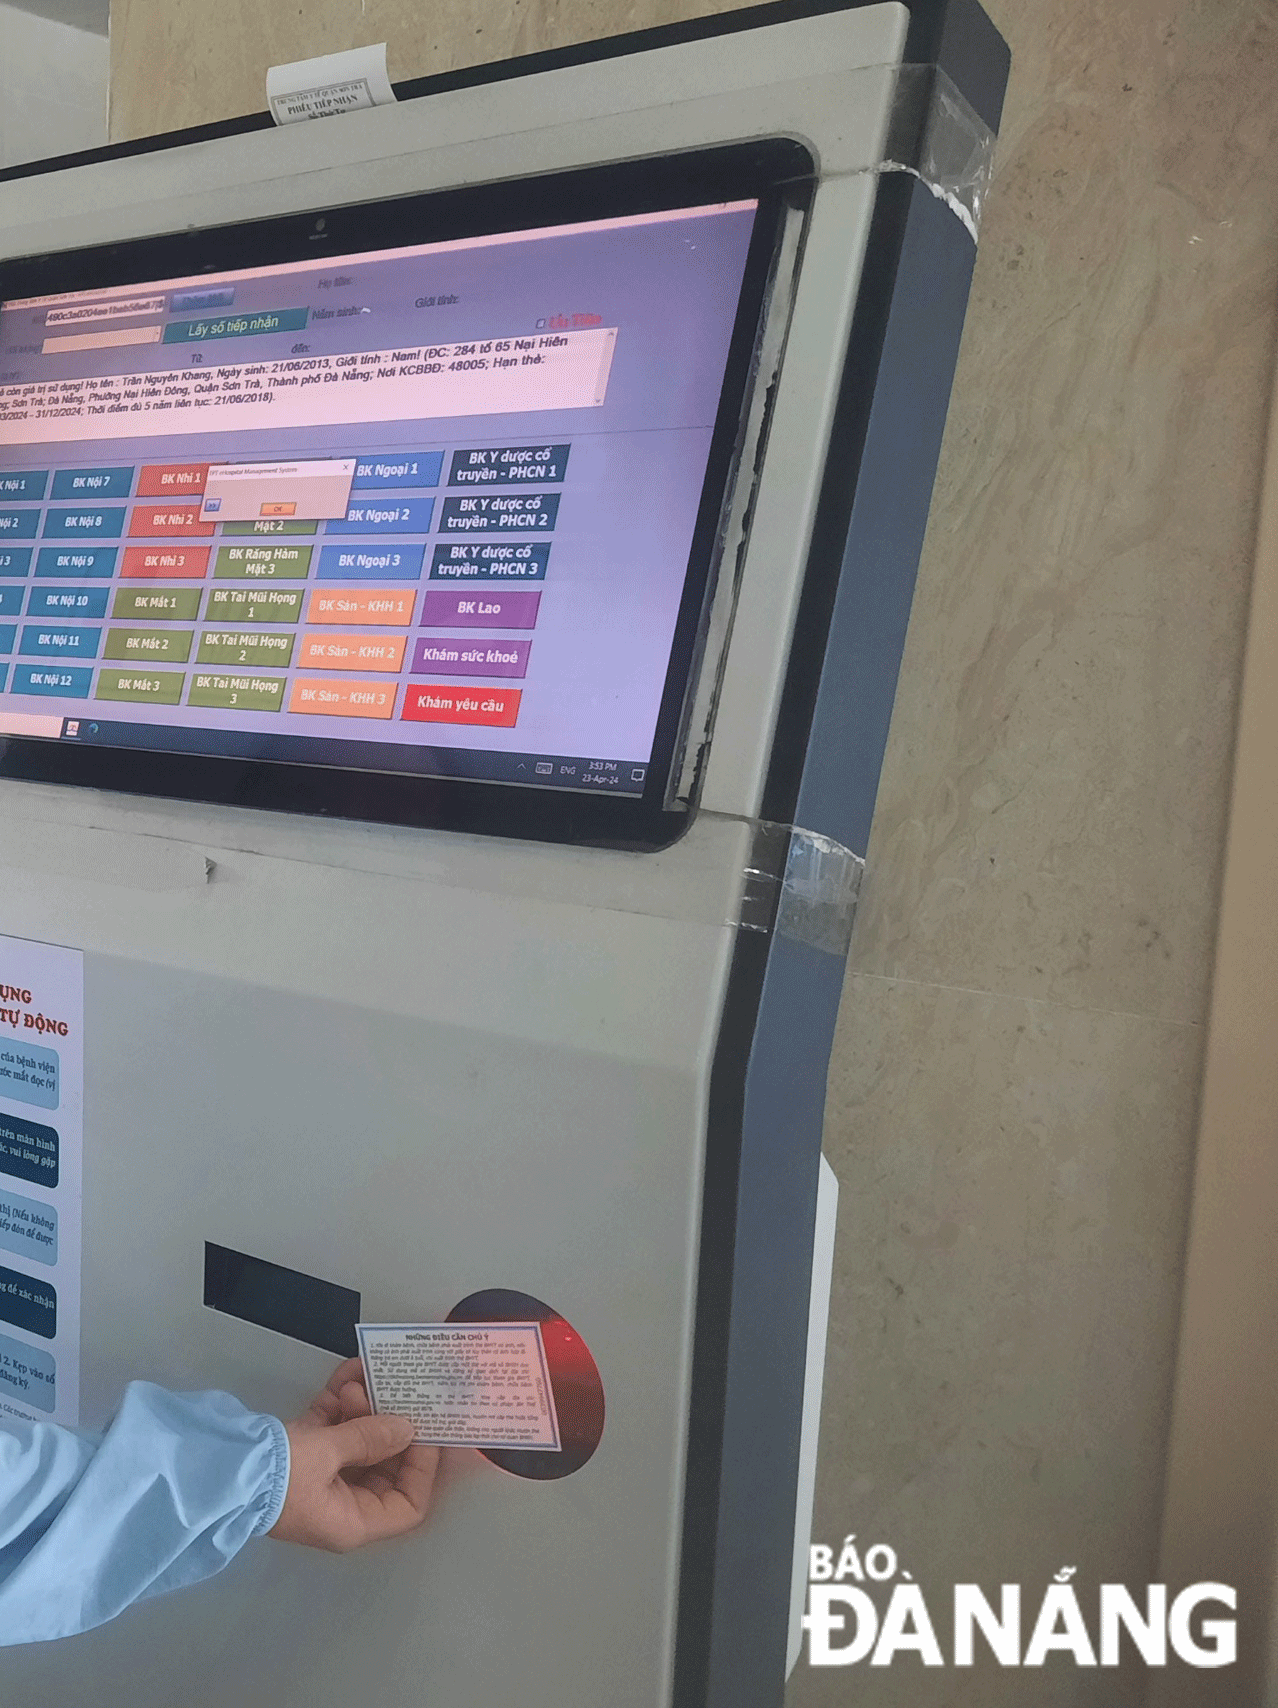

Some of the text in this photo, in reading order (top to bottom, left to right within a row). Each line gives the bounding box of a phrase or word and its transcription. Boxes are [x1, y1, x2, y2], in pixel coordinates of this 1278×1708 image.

[288, 94, 358, 115] PHIẾU TIẾP NHẬN
[189, 314, 279, 338] Lấy số tiếp nhận
[181, 370, 214, 382] Khang,
[217, 366, 242, 380] Ngày
[244, 364, 269, 376] sinh:
[271, 358, 332, 374] 21/06/2013,
[336, 356, 357, 368] Giới
[360, 354, 381, 364] tính
[391, 349, 421, 362] Nam!
[424, 346, 450, 362] (ĐC:
[454, 344, 476, 356] 284
[495, 340, 510, 352] 65
[514, 338, 536, 352] Nại
[539, 336, 568, 348] Hiên
[222, 380, 241, 392] Sơn
[244, 378, 263, 390] Trà,
[268, 376, 298, 388] Thành
[324, 372, 338, 383] Đà
[377, 366, 396, 378] Nơi
[399, 362, 444, 376] KCBBĐ:
[448, 358, 490, 372] 48005;
[493, 355, 518, 370] Hạn
[144, 402, 150, 411] 5
[152, 400, 172, 410] năm
[469, 446, 552, 465] BK Y dược cổ
[357, 463, 418, 478] BK Ngoại 1
[456, 468, 498, 482] truyền
[508, 466, 543, 478] PHCN
[548, 465, 556, 477] 1
[5, 478, 19, 492] Nội
[20, 479, 26, 490] 1
[161, 473, 201, 484] BK Nhi 1
[229, 548, 298, 562] BK Răng Hàm
[246, 564, 276, 577] Mặt 3
[134, 596, 176, 608] BK Mắt 1
[214, 591, 296, 606] BK Tai Mũi Họng
[248, 607, 254, 617] 1
[319, 600, 334, 611] BK
[336, 600, 358, 612] Sản
[368, 601, 394, 612] KHH
[396, 601, 404, 612] 1
[458, 601, 501, 614] BK Lao
[424, 648, 518, 664] Khám sức khoẻ
[30, 674, 72, 688] BK Nội 12
[418, 695, 504, 713] Khám yêu cầu
[560, 761, 618, 775] ENG 3:53 PM
[582, 774, 619, 785] 23-Apr-24
[24, 1012, 69, 1036] ĐỘNG
[16, 1054, 36, 1069] bệnh
[38, 1061, 56, 1074] viện
